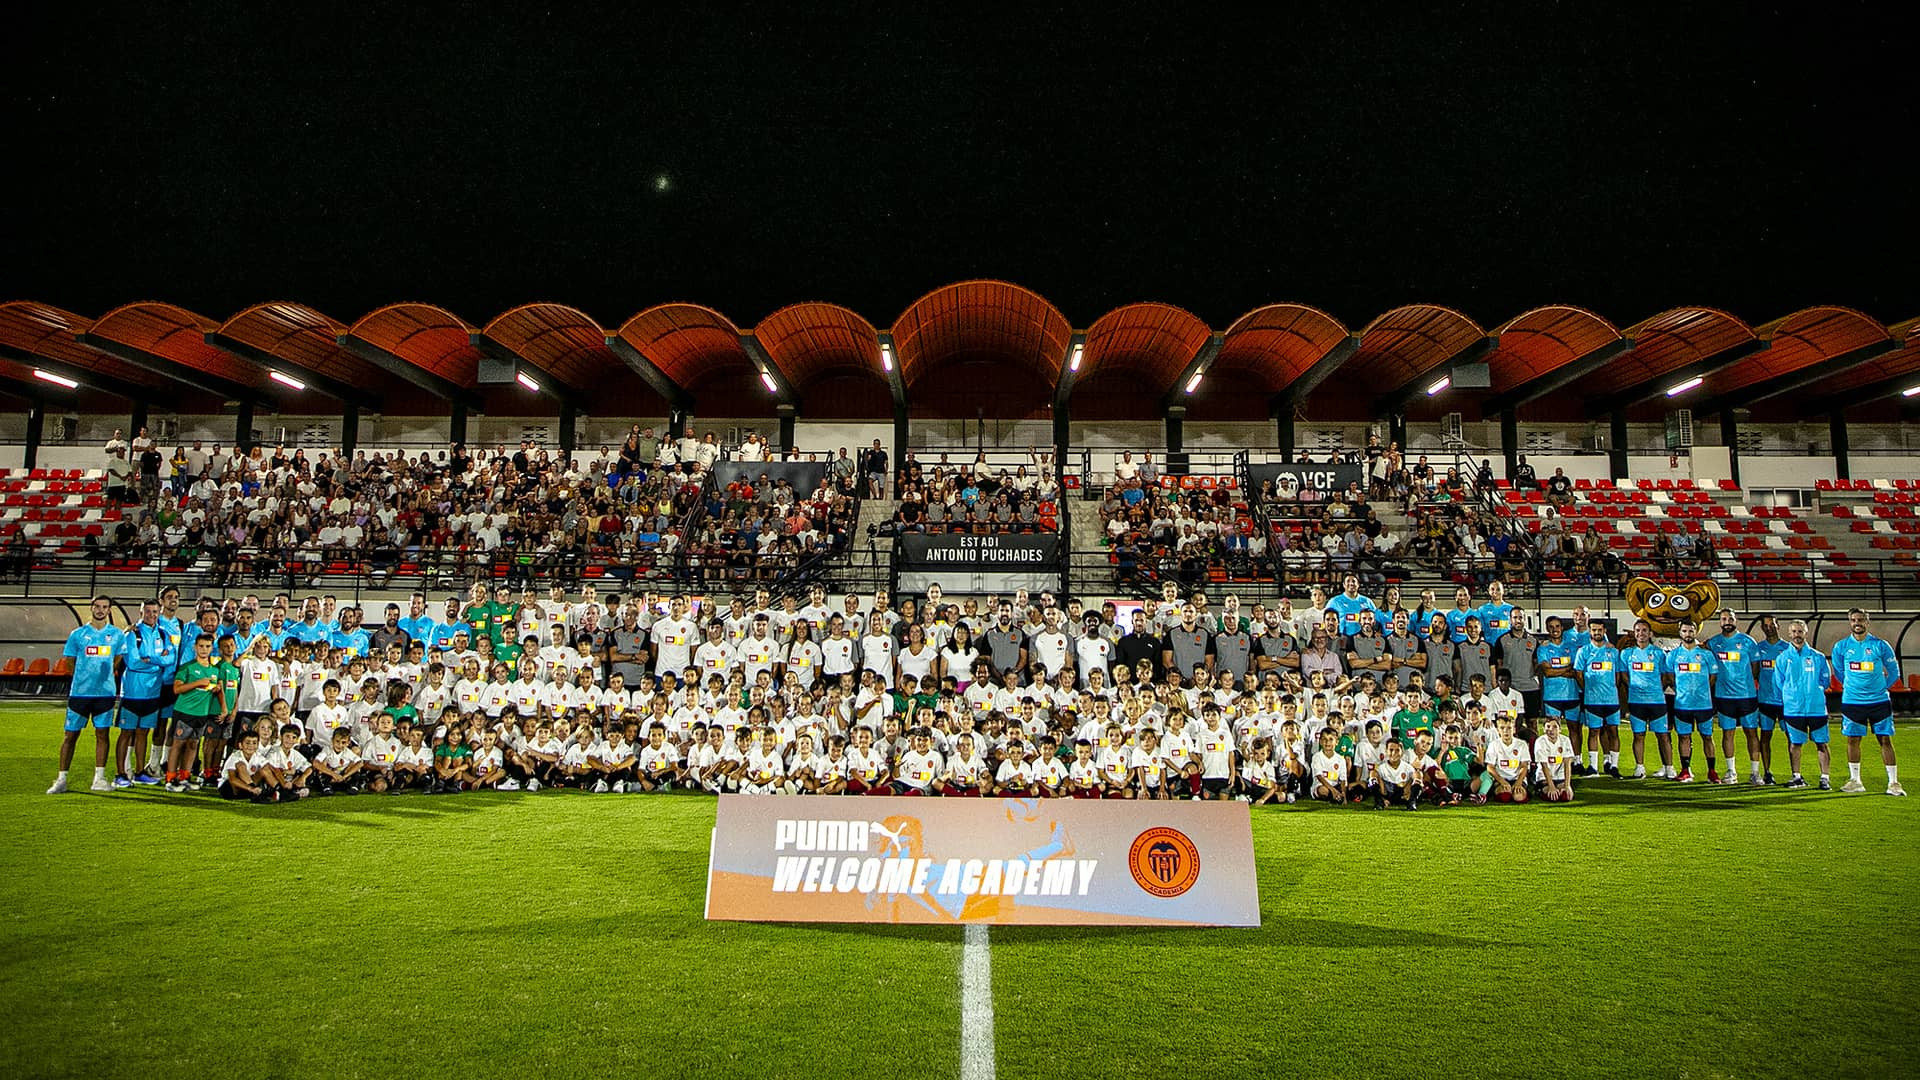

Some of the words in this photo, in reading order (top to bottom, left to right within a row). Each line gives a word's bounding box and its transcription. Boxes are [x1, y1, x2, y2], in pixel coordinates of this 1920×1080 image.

[1301, 471, 1336, 489] VCF
[960, 536, 999, 547] ESTADI
[926, 548, 977, 561] ANTONIO
[981, 549, 1043, 562] PUCHADES
[775, 820, 870, 851] PUMA
[772, 856, 932, 894] WELCOME
[937, 858, 1098, 896] ACADEMY
[1148, 886, 1184, 895] ACADEMIA
